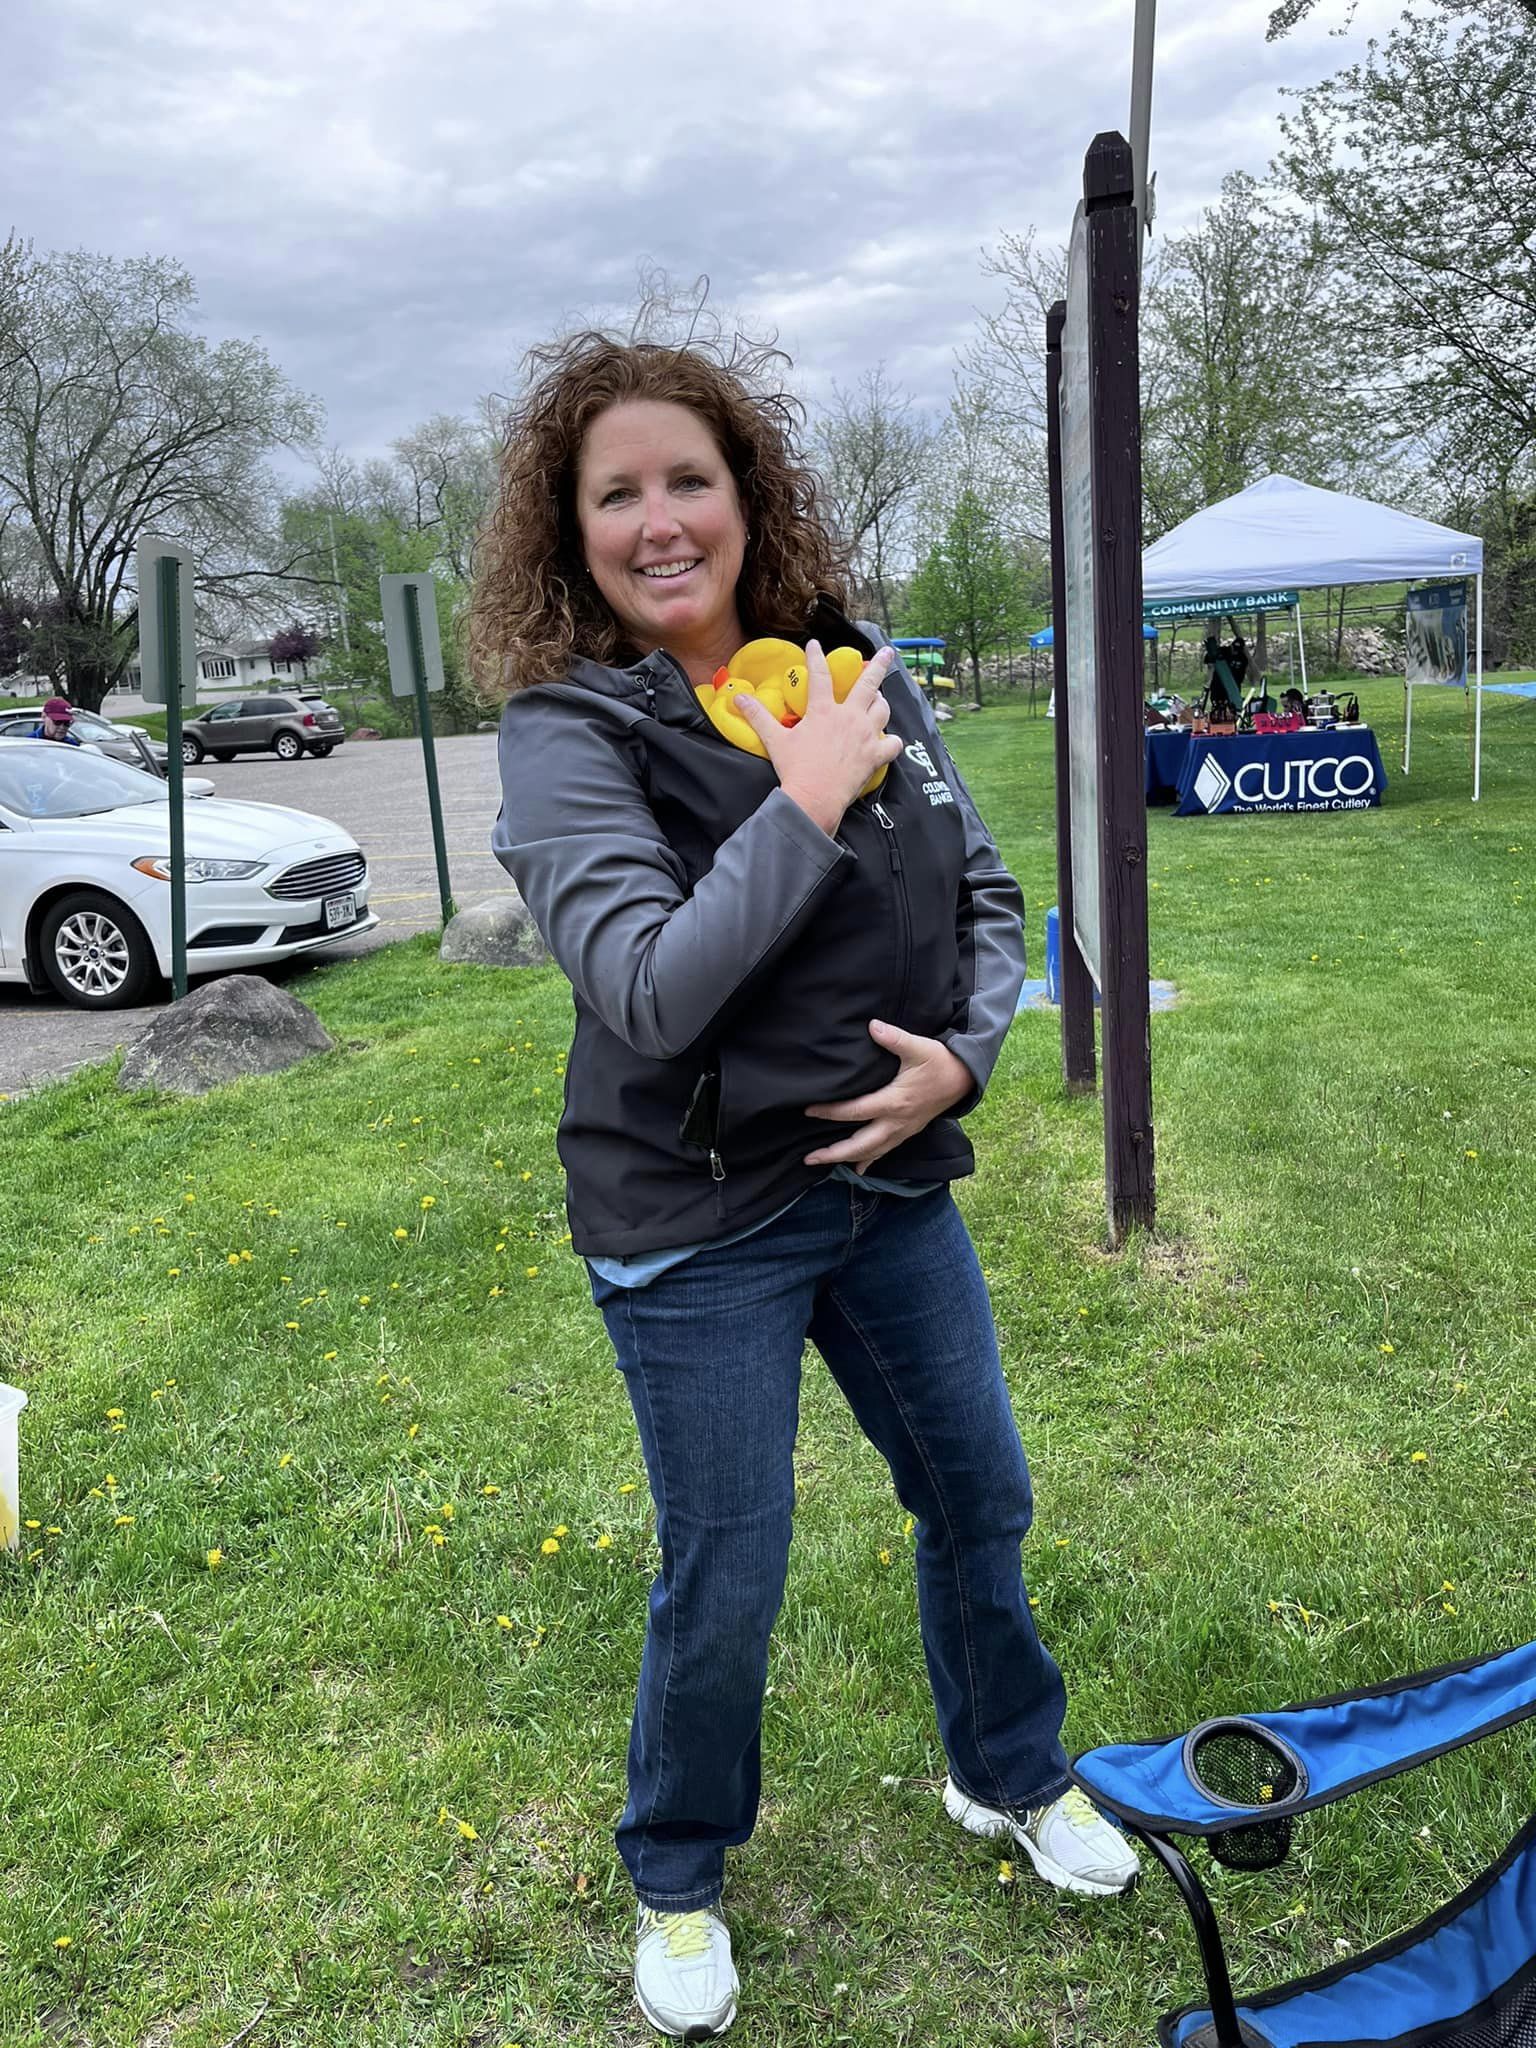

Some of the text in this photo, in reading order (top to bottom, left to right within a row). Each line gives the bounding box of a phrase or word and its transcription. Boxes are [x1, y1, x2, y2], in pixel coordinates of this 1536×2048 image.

[1151, 598, 1240, 616] COMMUNITY
[1246, 592, 1288, 606] BANK
[1233, 755, 1374, 802] CUTCO
[1255, 802, 1294, 812] World's
[1297, 801, 1329, 810] Finest
[1331, 798, 1371, 810] Cutlery
